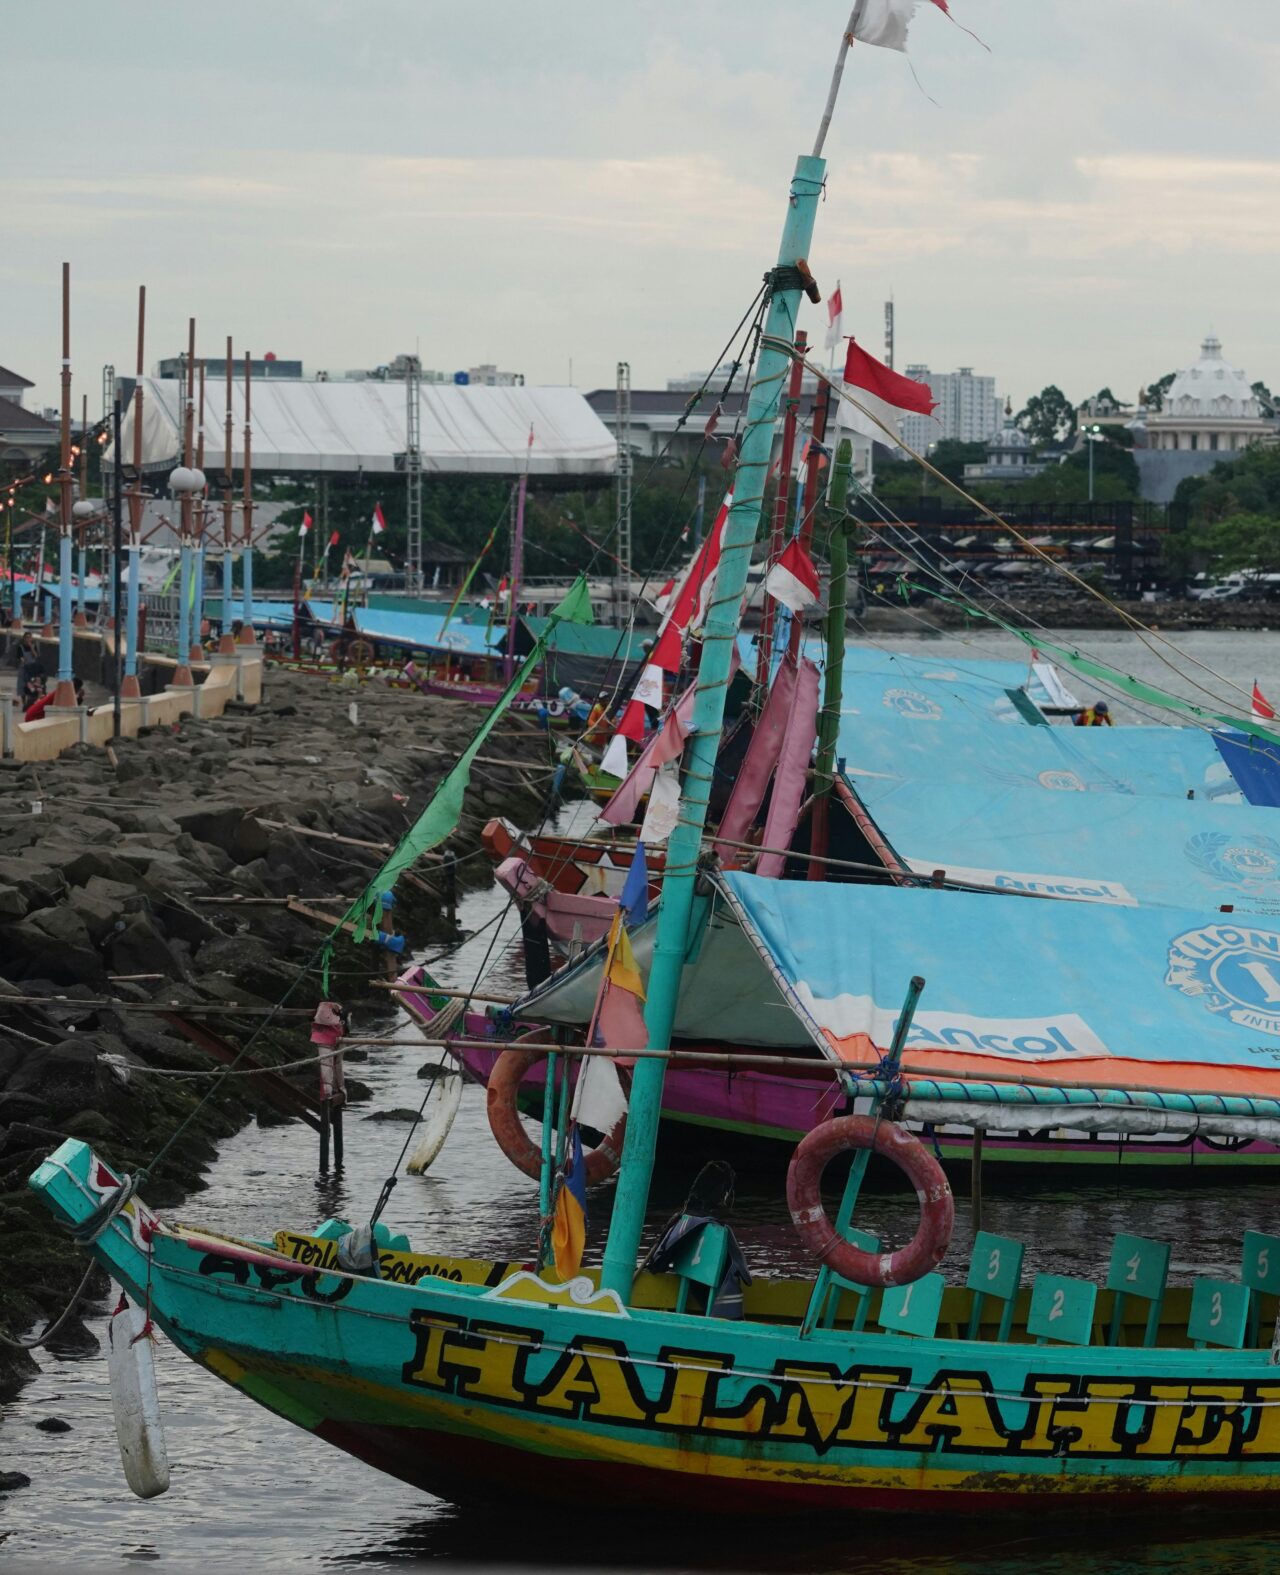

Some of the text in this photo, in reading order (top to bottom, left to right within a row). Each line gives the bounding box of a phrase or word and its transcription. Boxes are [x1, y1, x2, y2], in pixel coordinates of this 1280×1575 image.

[994, 874, 1118, 898] Ancol
[892, 1018, 1079, 1055] Ancol
[987, 1248, 1001, 1281] 3
[1125, 1251, 1142, 1282] 4
[1256, 1248, 1270, 1279] 5
[898, 1284, 913, 1318] 1
[1049, 1289, 1065, 1322] 2
[1209, 1291, 1223, 1327] 3
